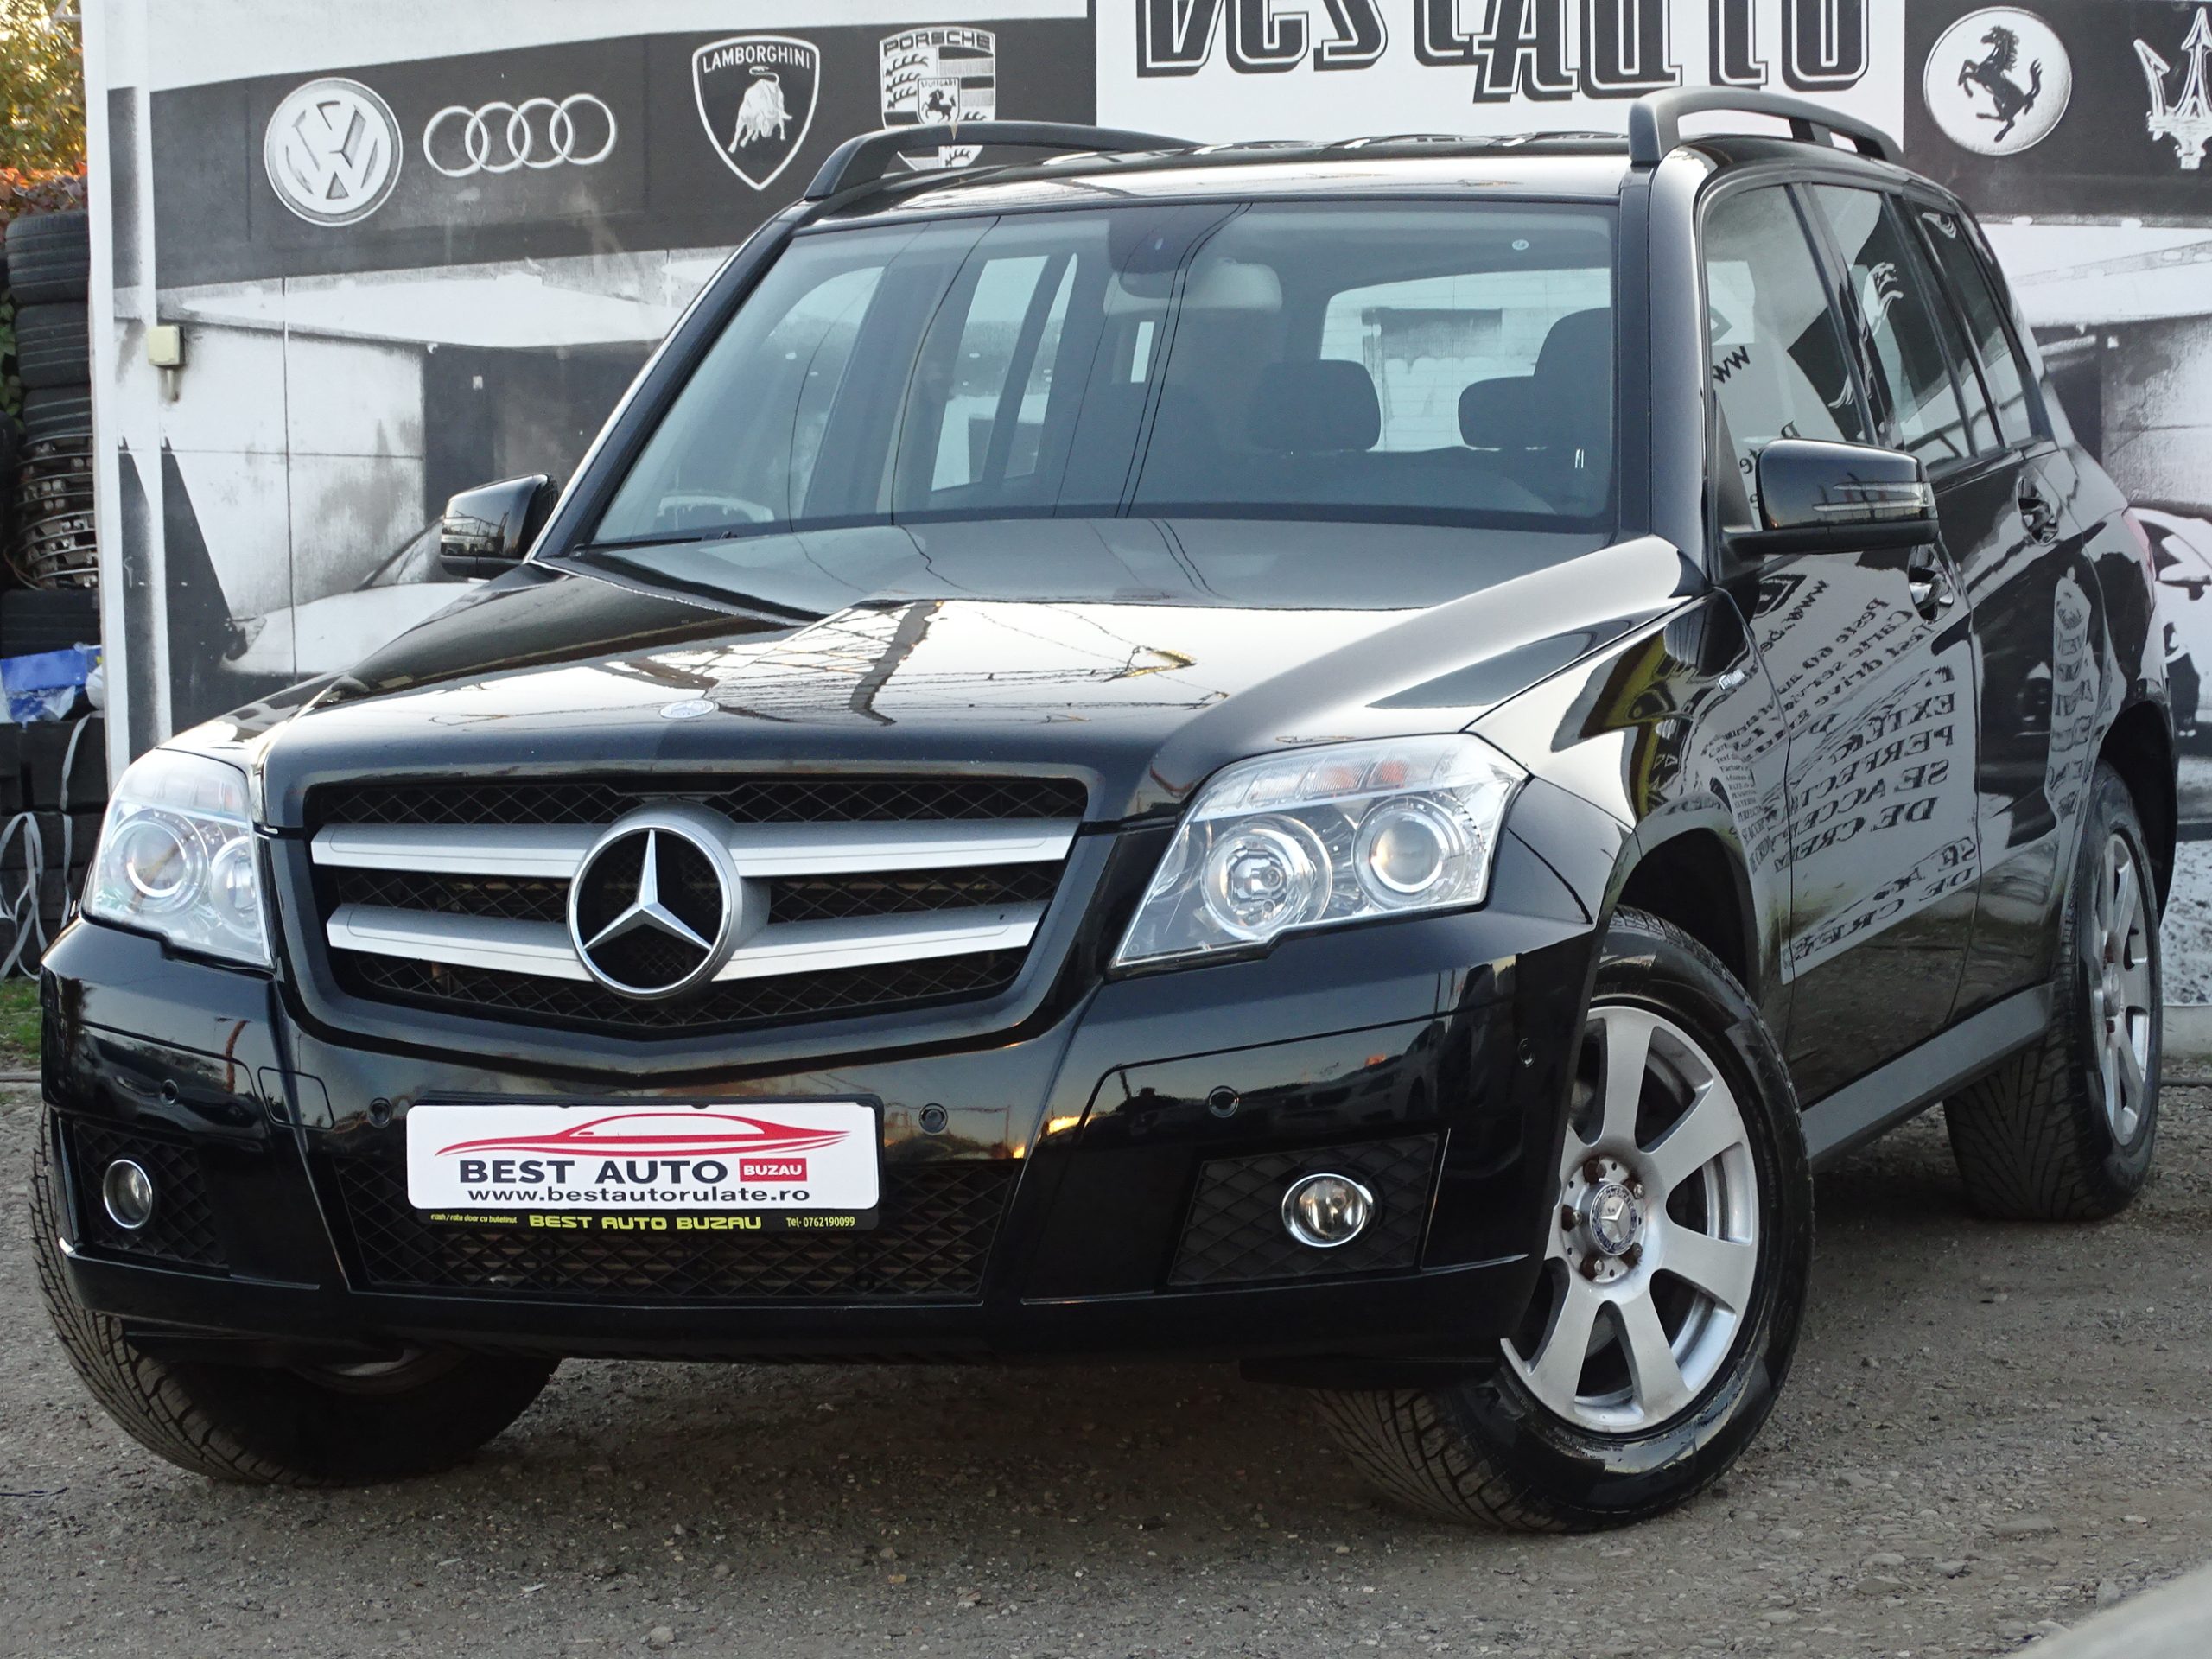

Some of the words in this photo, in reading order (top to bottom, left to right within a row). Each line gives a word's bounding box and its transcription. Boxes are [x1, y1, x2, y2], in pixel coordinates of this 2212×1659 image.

[884, 31, 991, 56] PORSCHE
[702, 45, 810, 73] LAMBORGHINI
[460, 1160, 567, 1184] BEST
[594, 1160, 728, 1184] AUTO
[743, 1163, 802, 1176] BUZAU
[467, 1186, 810, 1203] www.bestautorulate.ro
[529, 1215, 593, 1229] BEST
[601, 1216, 666, 1230] AUTO
[676, 1216, 761, 1230] BUZAU
